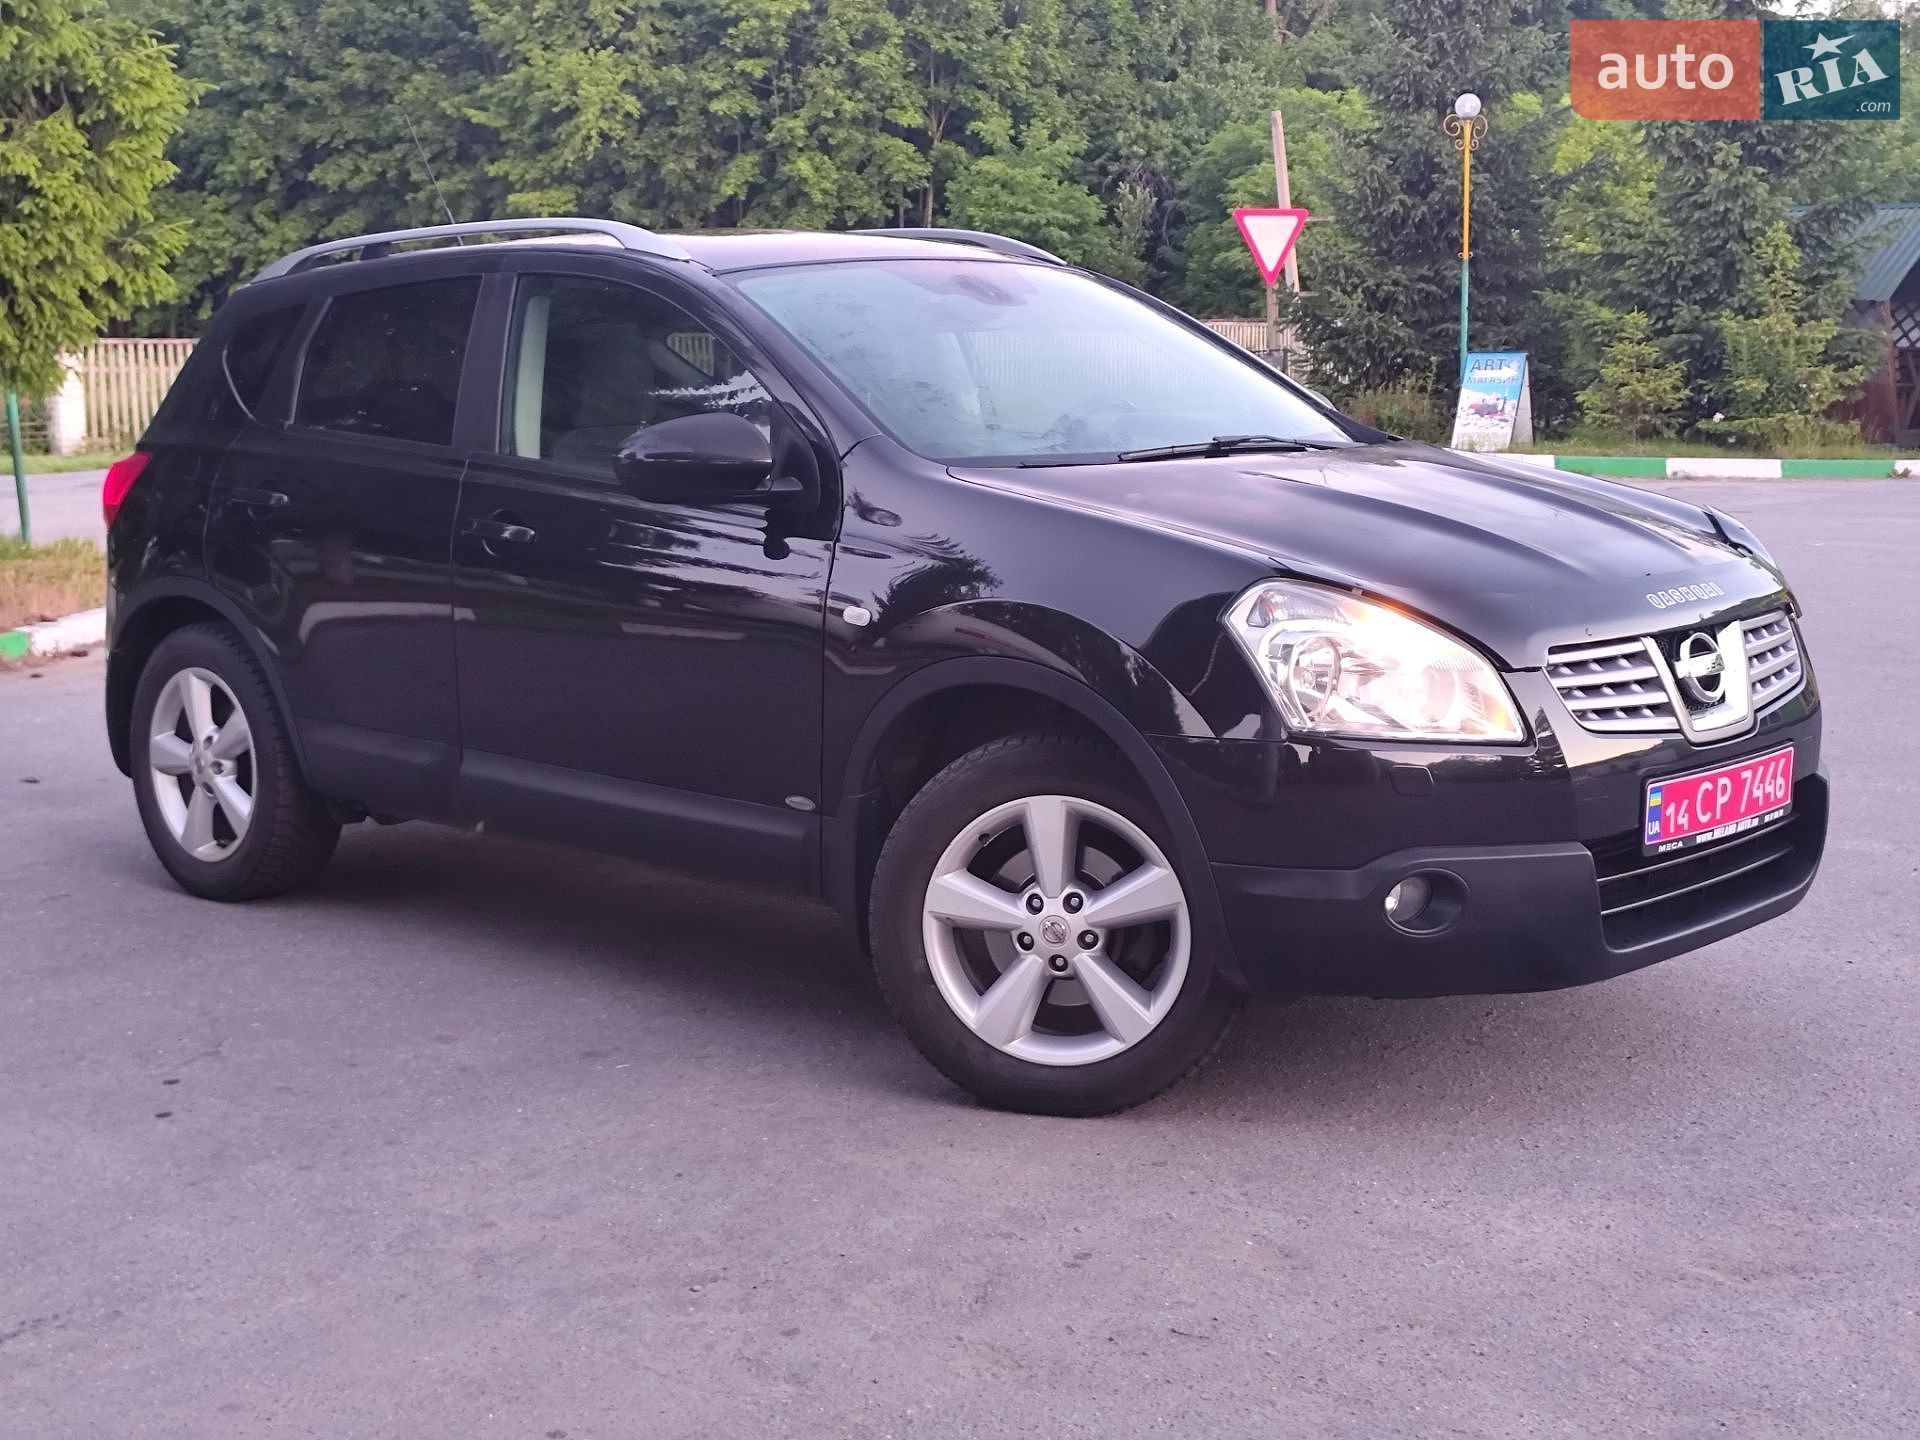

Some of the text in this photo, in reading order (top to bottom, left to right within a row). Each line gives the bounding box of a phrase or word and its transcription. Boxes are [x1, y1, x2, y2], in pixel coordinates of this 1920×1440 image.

[1646, 582, 1725, 609] QASHQAI
[1665, 757, 1787, 834] 14 CP 7446
[1648, 820, 1660, 835] UA
